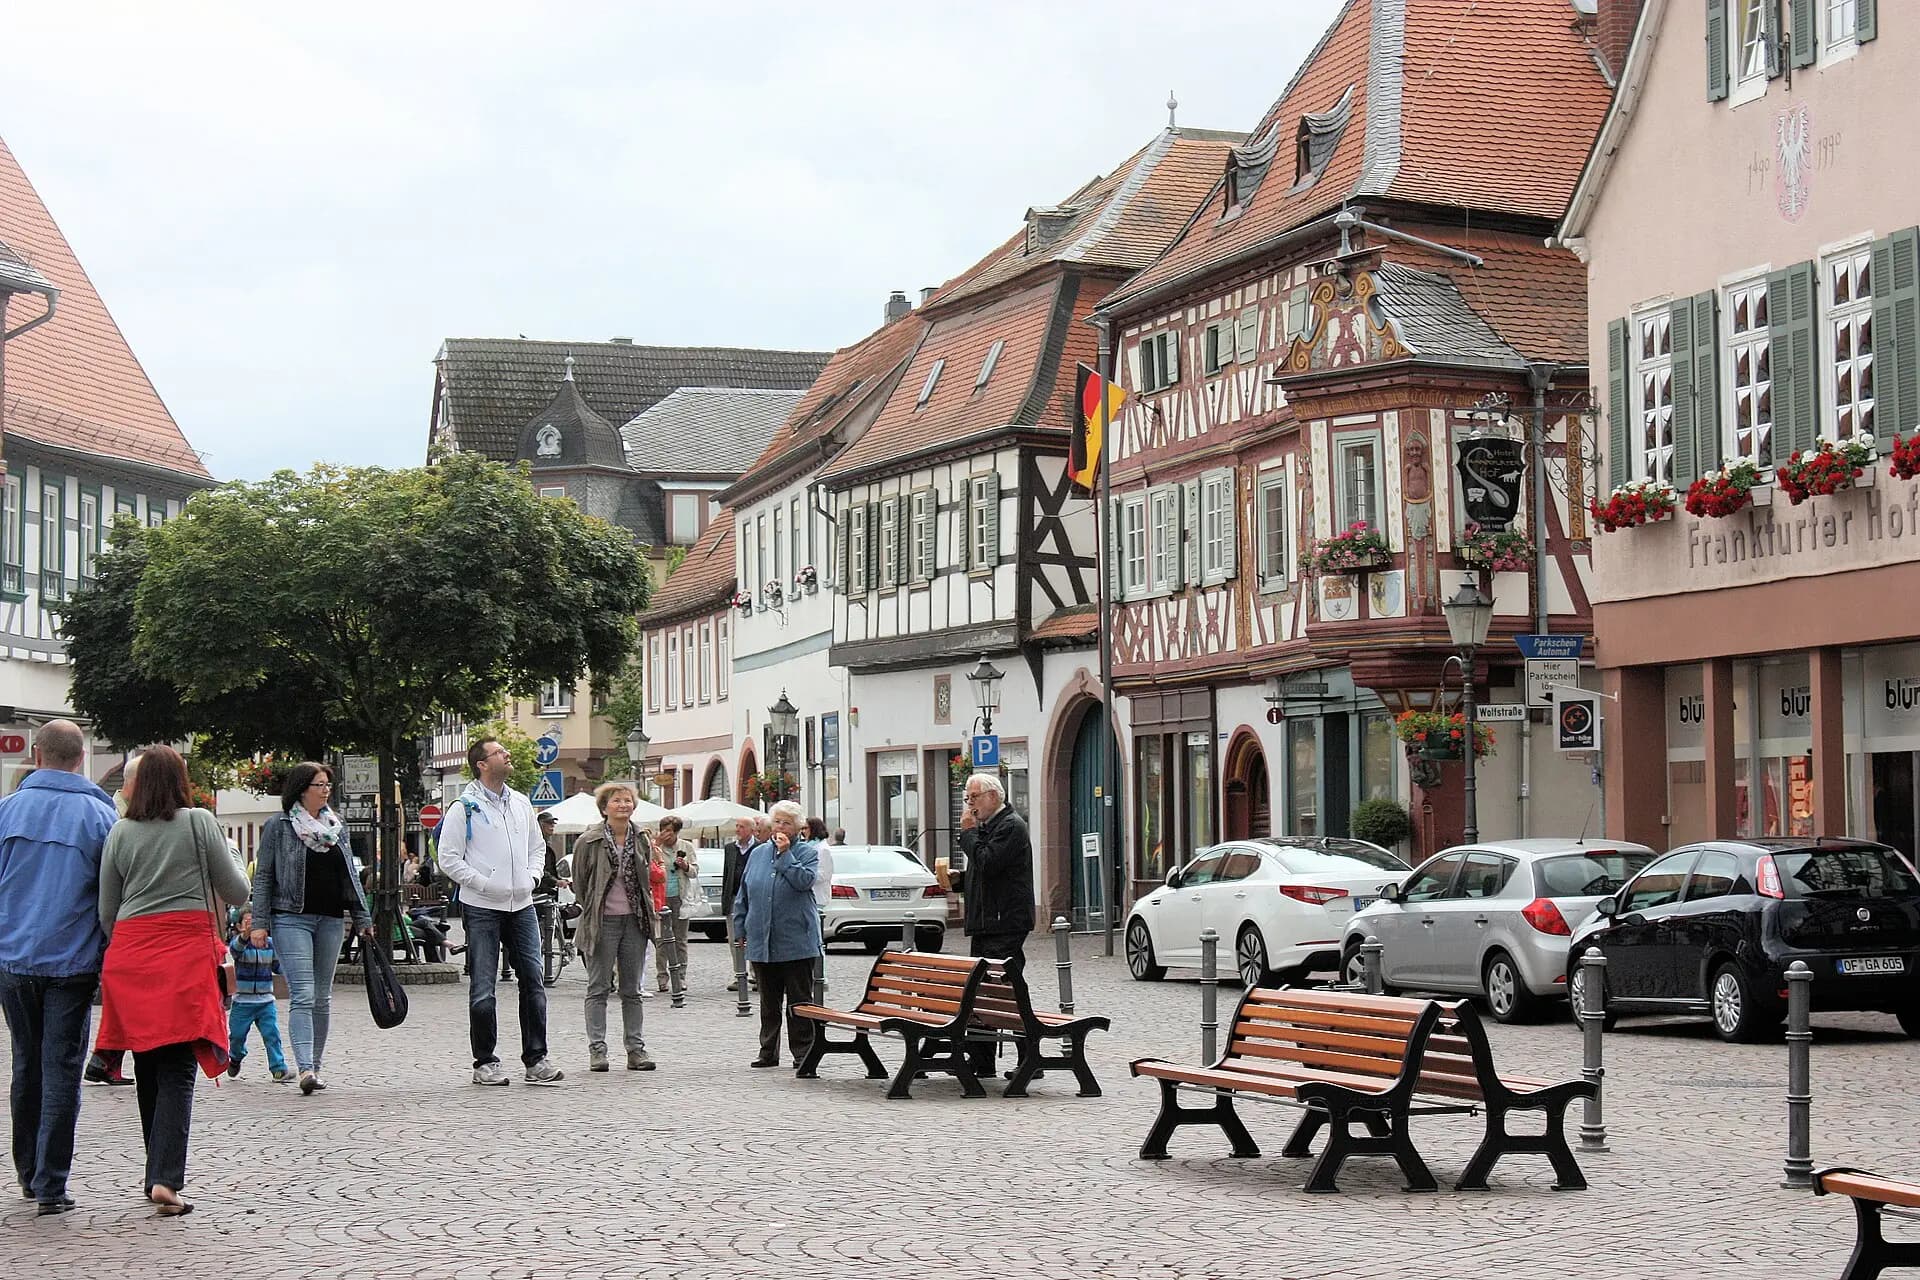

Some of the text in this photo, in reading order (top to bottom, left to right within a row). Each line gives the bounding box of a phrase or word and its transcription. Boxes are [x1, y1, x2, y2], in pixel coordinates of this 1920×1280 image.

[1688, 483, 1920, 569] Frankfurter Hof
[1534, 637, 1577, 648] Parkschein
[1537, 647, 1570, 656] Automat
[1543, 662, 1561, 670] Hier
[1529, 672, 1576, 681] Parkschein
[1541, 681, 1554, 691] lös
[1478, 706, 1523, 718] Wolfstraße
[1679, 696, 1705, 724] blu
[978, 739, 993, 763] P
[1844, 957, 1903, 971] OF GA 605
